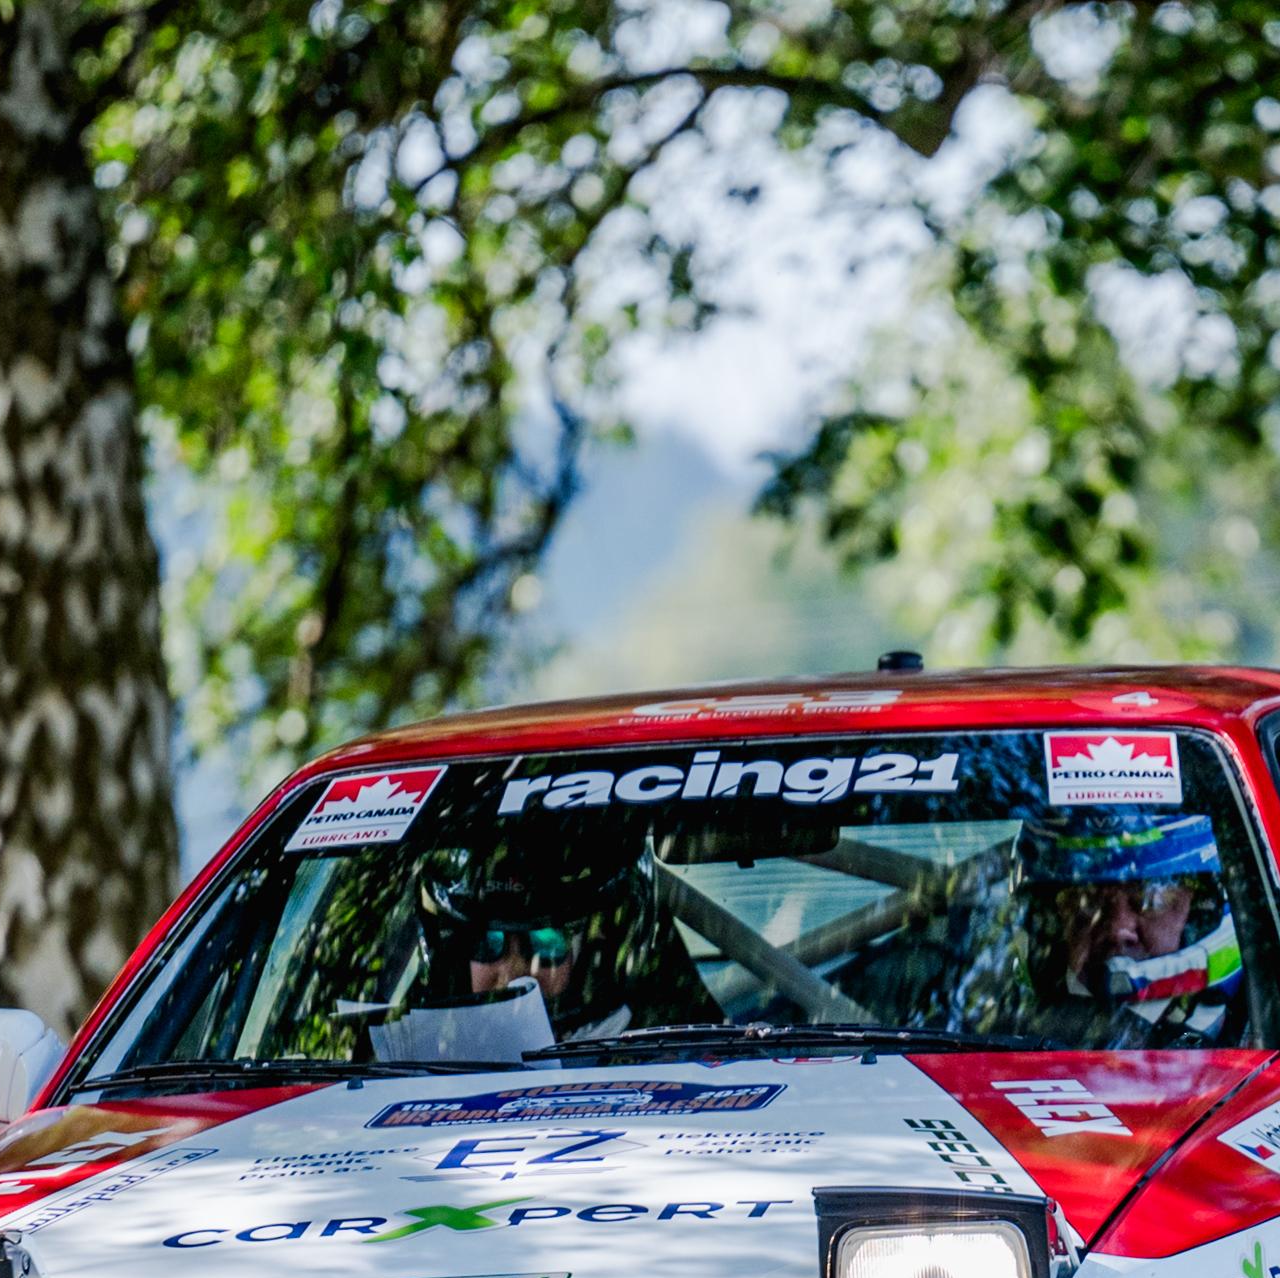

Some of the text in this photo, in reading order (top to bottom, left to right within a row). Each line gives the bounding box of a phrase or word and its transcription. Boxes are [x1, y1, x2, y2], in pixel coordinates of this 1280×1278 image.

[1112, 692, 1159, 707] 4
[496, 750, 960, 815] racing21
[1067, 790, 1164, 800] LUBRICANTS
[302, 829, 390, 846] LUBRICANTS
[991, 1079, 1134, 1138] FLEX
[903, 1118, 1014, 1192] SPEDIC
